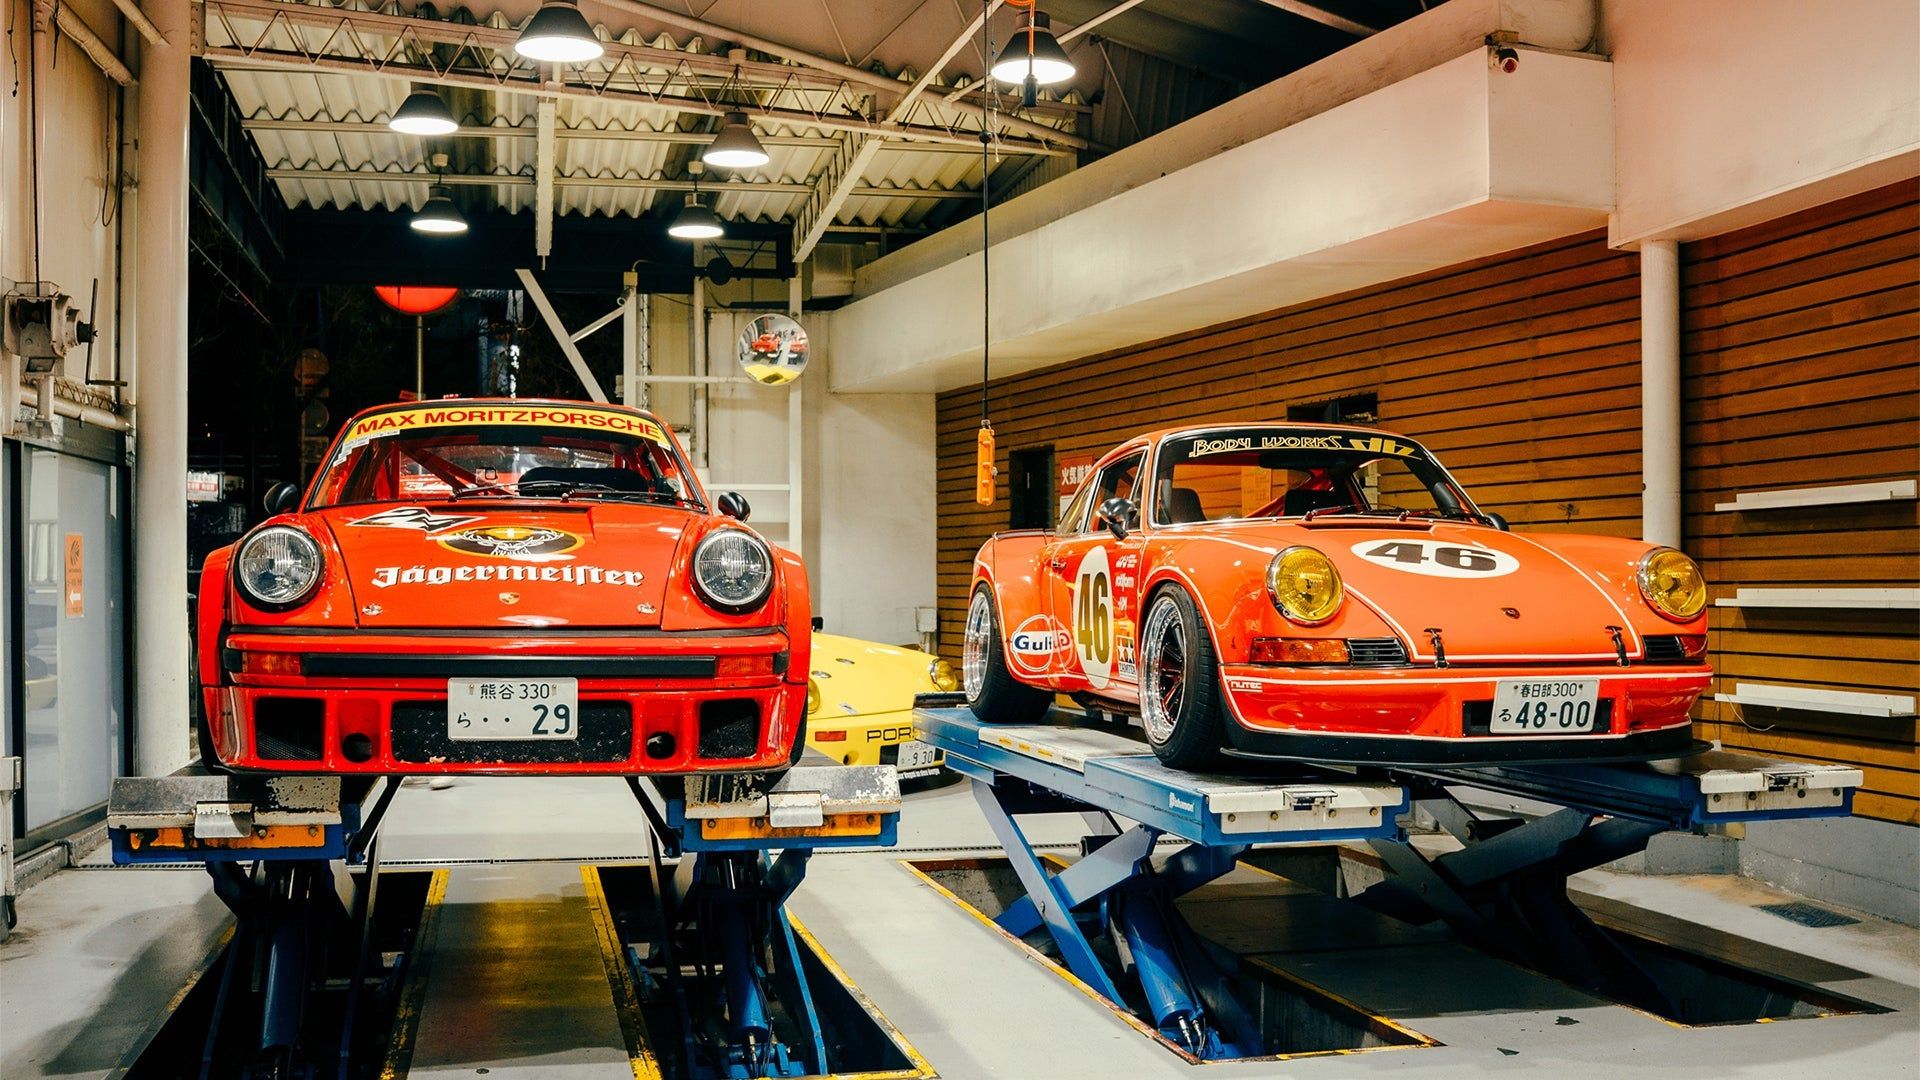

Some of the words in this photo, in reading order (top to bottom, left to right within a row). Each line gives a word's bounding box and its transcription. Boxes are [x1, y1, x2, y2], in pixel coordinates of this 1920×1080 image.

[356, 414, 416, 435] MAX
[1365, 542, 1497, 572] 46
[1078, 571, 1110, 665] 46
[532, 703, 571, 735] 29
[1515, 701, 1591, 729] 48-00
[866, 726, 915, 743] POR
